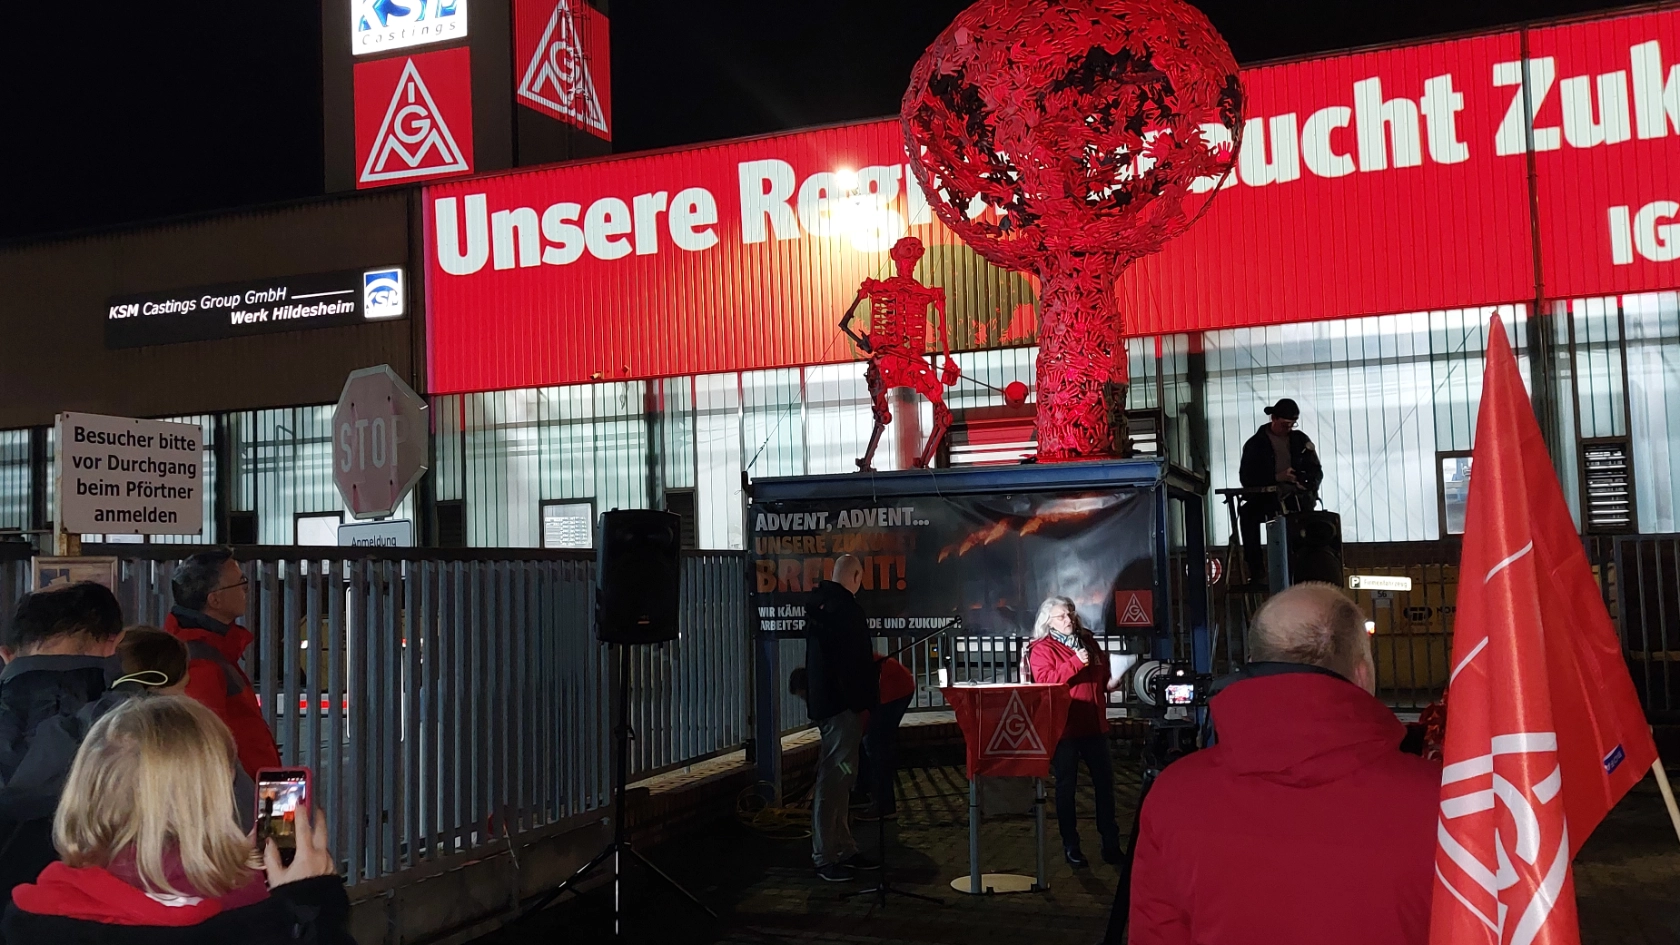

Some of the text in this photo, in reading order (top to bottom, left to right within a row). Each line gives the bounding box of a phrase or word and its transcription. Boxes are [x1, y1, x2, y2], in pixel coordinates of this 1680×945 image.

[362, 21, 456, 45] Castings
[374, 81, 455, 173] IGM
[434, 187, 719, 276] Unsere
[1608, 200, 1680, 265] IG
[109, 287, 287, 319] KSM Castings Group GmbH
[230, 300, 354, 325] Werk Hildesheim
[74, 426, 196, 451] Besucher bitte
[341, 414, 409, 473] STOP
[72, 454, 197, 479] vor Durchgang
[77, 478, 194, 499] beim Pförtner
[94, 506, 177, 523] anmelden
[755, 512, 833, 533] ADVENT,
[352, 535, 397, 547] Anmeldung
[755, 535, 827, 555] UNSERE
[758, 606, 775, 618] WIR
[866, 617, 882, 629] DE
[883, 617, 906, 629] UND
